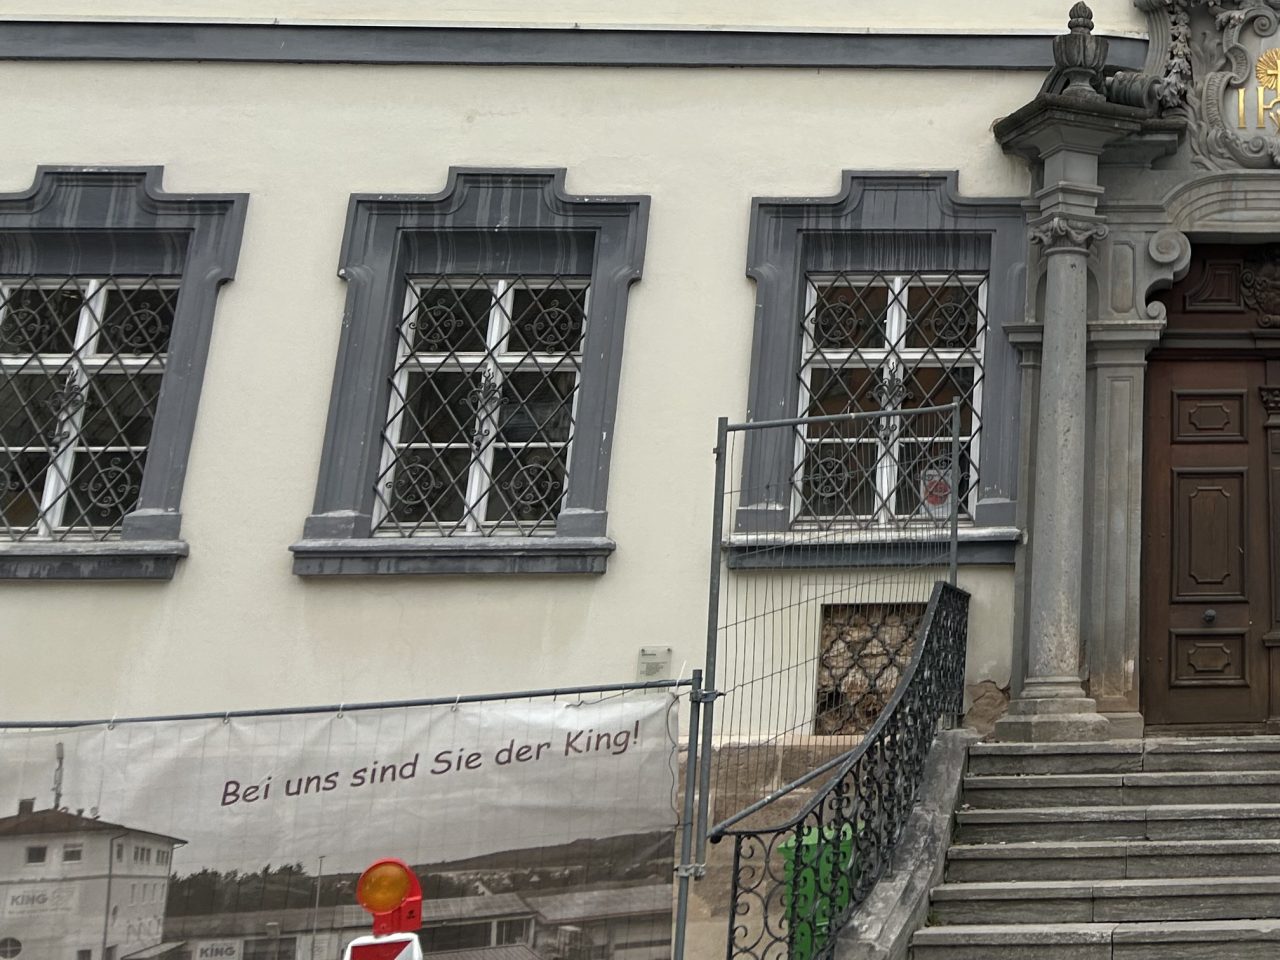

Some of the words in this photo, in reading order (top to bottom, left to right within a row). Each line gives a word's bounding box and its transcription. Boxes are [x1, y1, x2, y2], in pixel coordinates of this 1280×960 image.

[220, 776, 272, 807] Bei
[284, 771, 340, 797] uns
[349, 752, 420, 788] sind
[429, 747, 483, 775] Sie
[494, 738, 551, 766] der
[563, 719, 640, 756] King!
[10, 893, 48, 907] KING
[199, 945, 236, 959] KING
